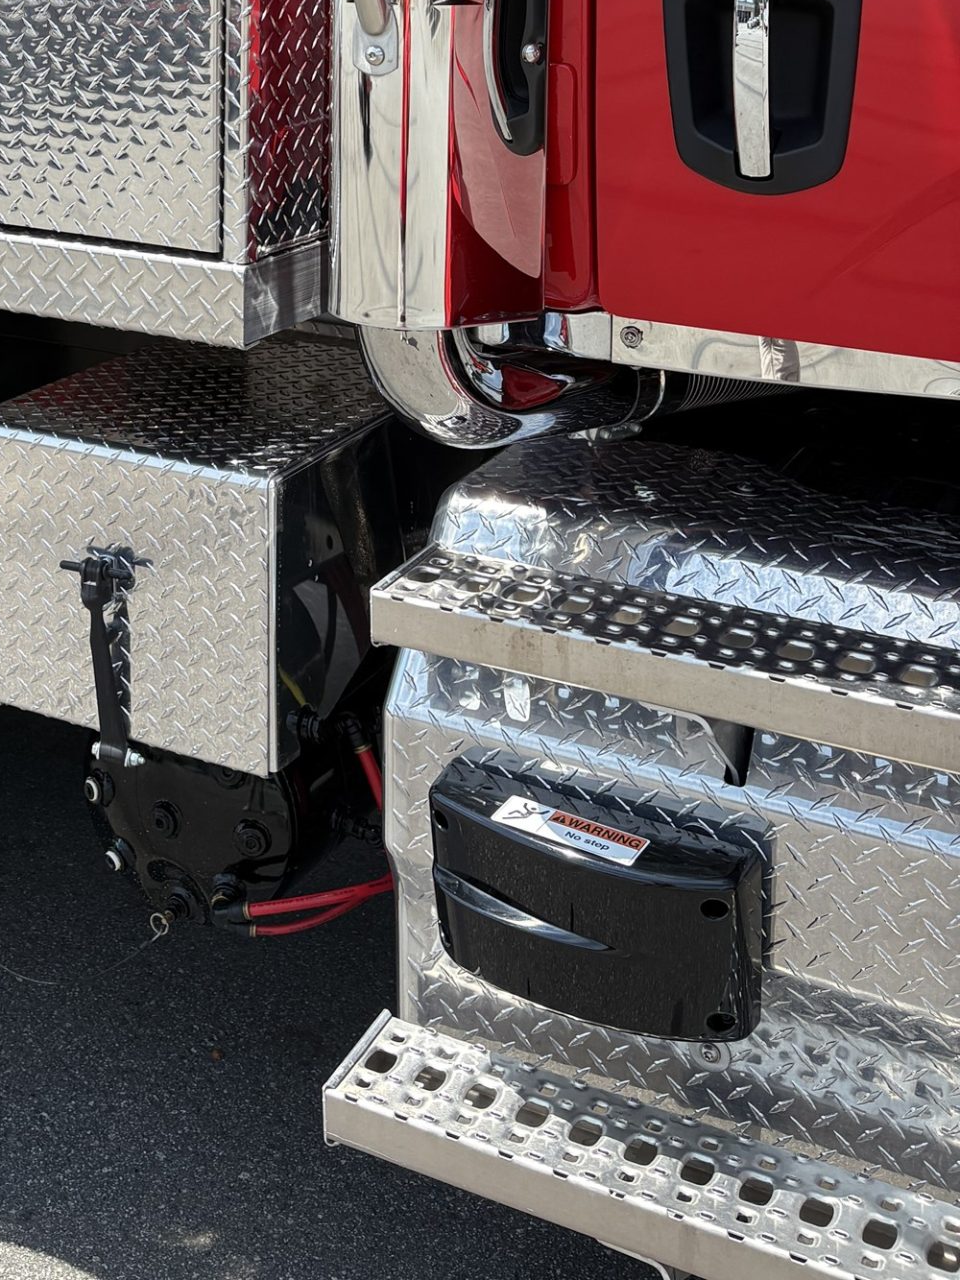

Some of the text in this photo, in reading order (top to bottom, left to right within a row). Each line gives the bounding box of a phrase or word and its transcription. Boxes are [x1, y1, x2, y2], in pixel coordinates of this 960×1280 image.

[565, 831, 610, 851] No step
[569, 818, 642, 849] WARNING
